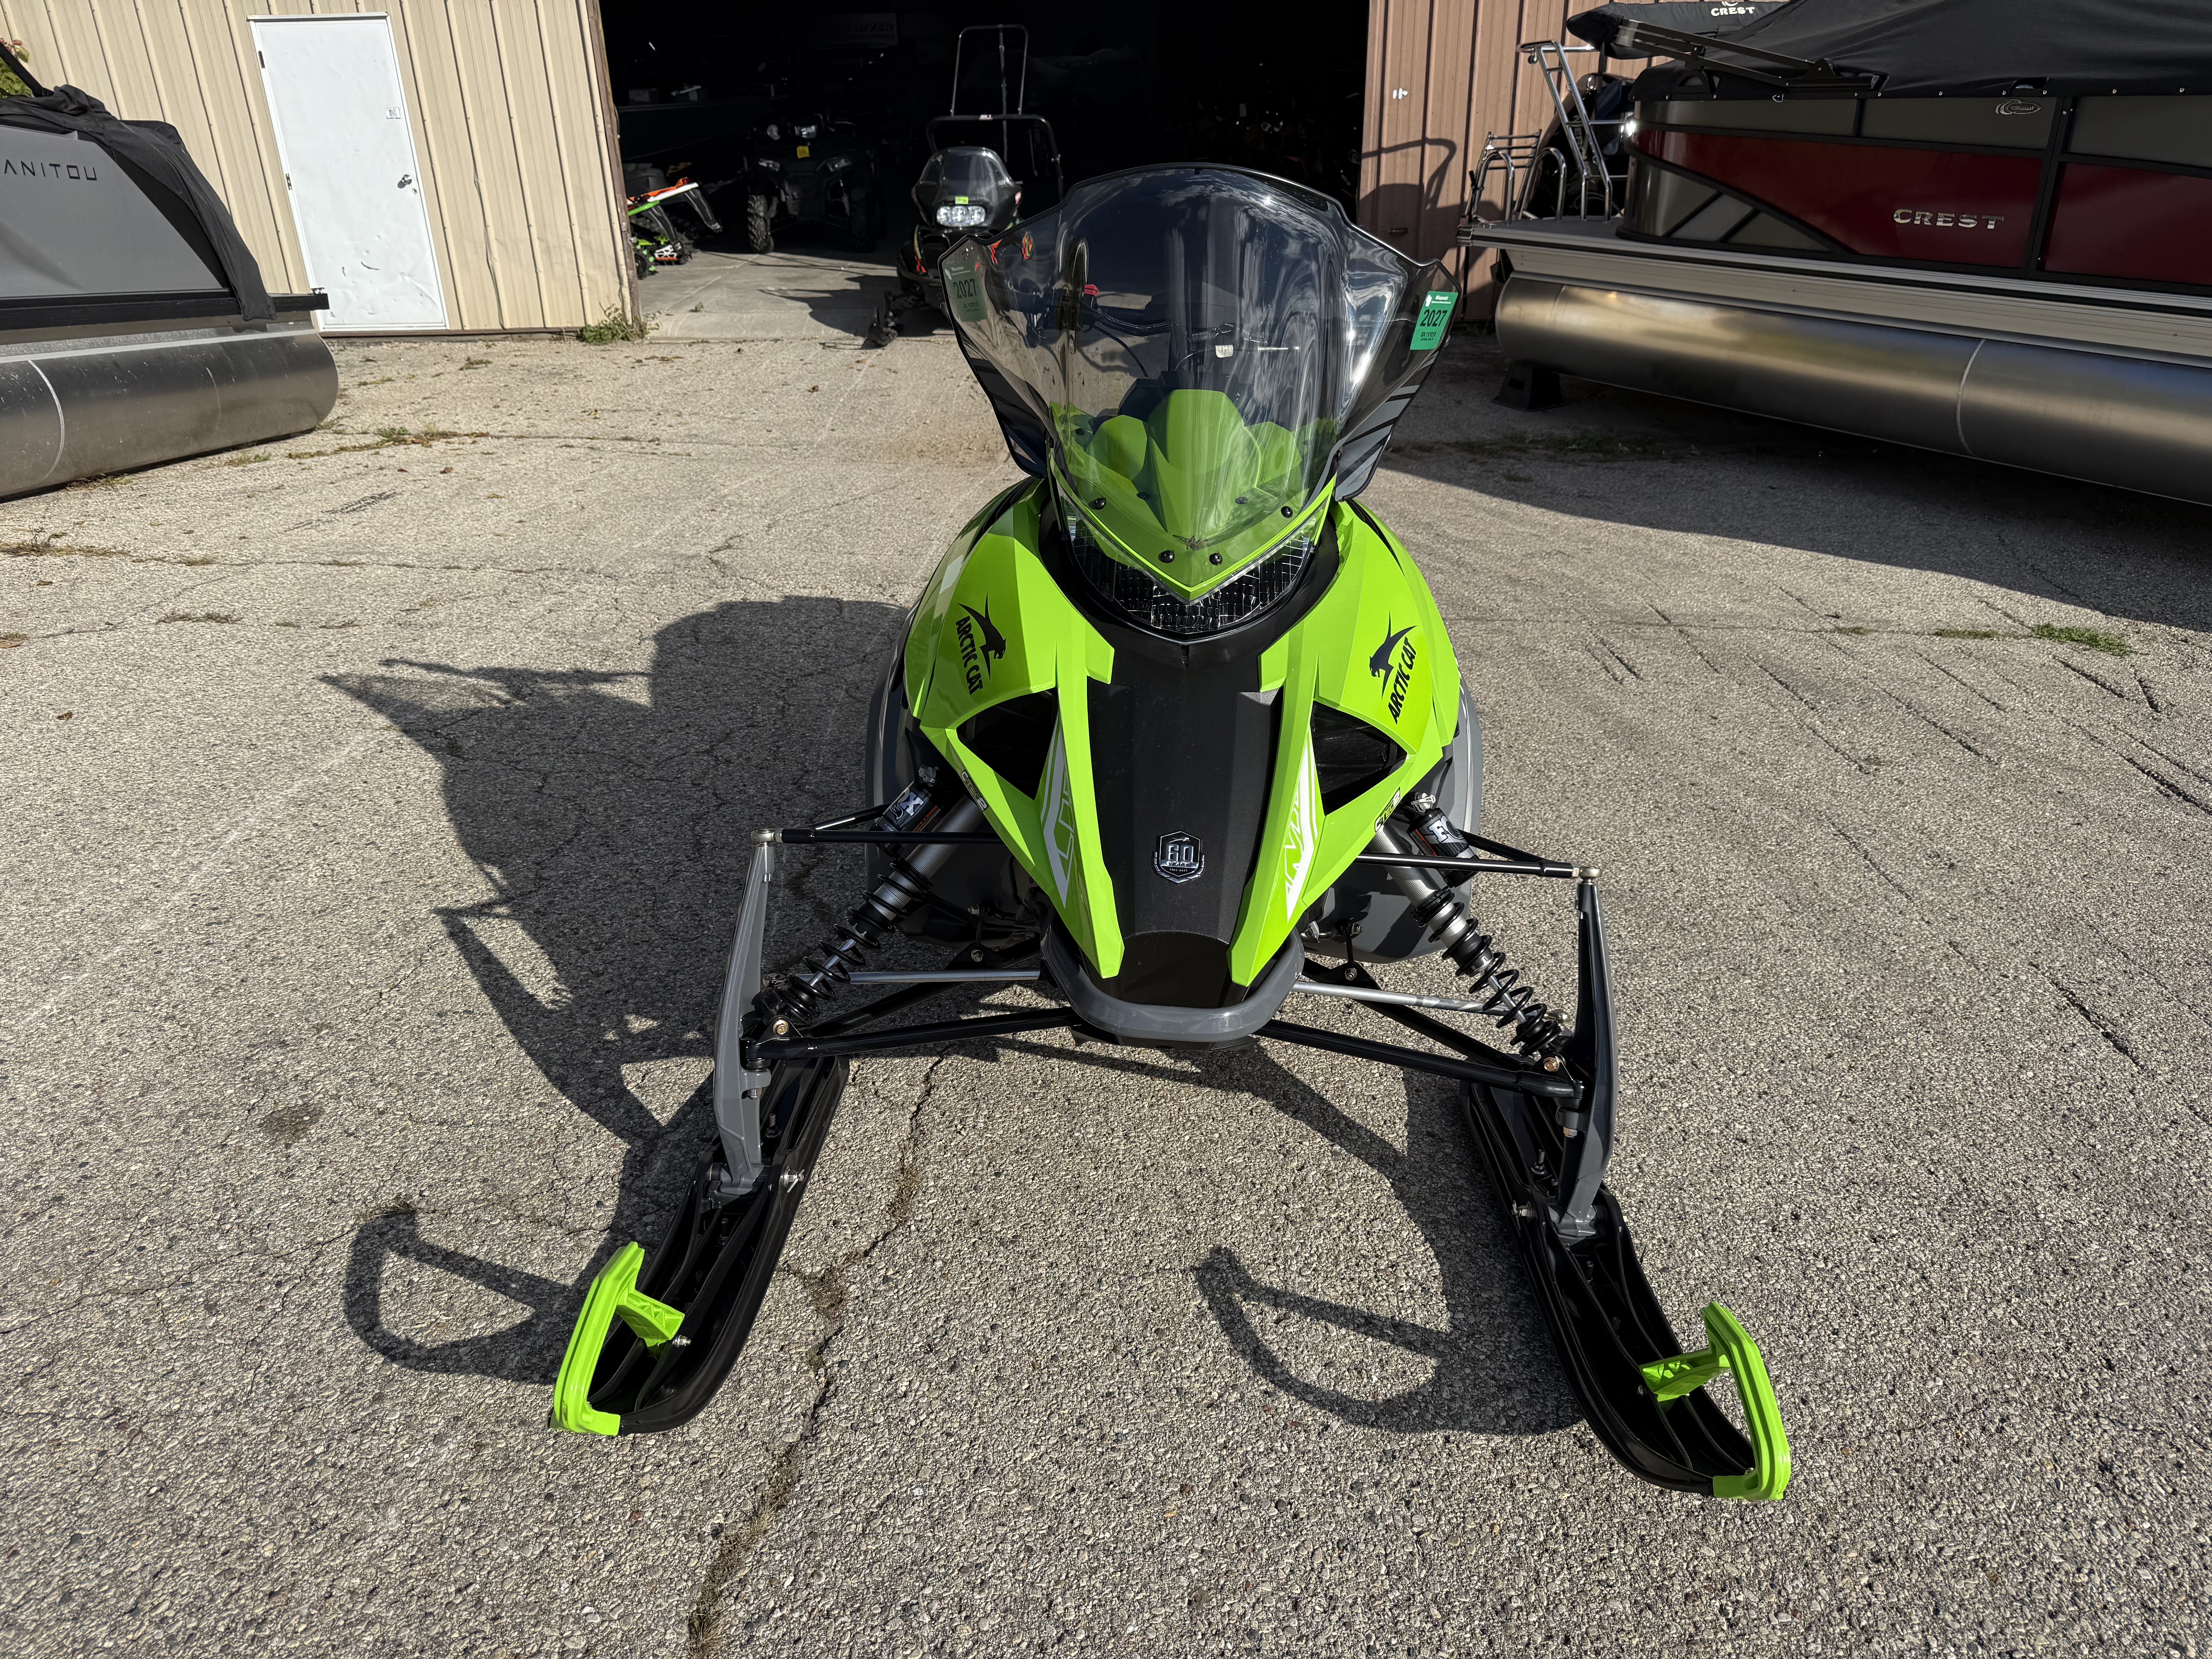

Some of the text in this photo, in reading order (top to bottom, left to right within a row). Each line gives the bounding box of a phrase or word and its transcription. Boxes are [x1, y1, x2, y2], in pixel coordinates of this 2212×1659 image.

[1711, 7, 1755, 16] CREST
[4, 159, 97, 181] ANITOU
[1894, 209, 2004, 229] CREST
[953, 278, 977, 299] 2027
[1420, 309, 1448, 327] 2027
[956, 615, 984, 695] ARCTIC CAT
[1388, 636, 1416, 725] ARCTIC CAT
[1166, 844, 1194, 863] 60
